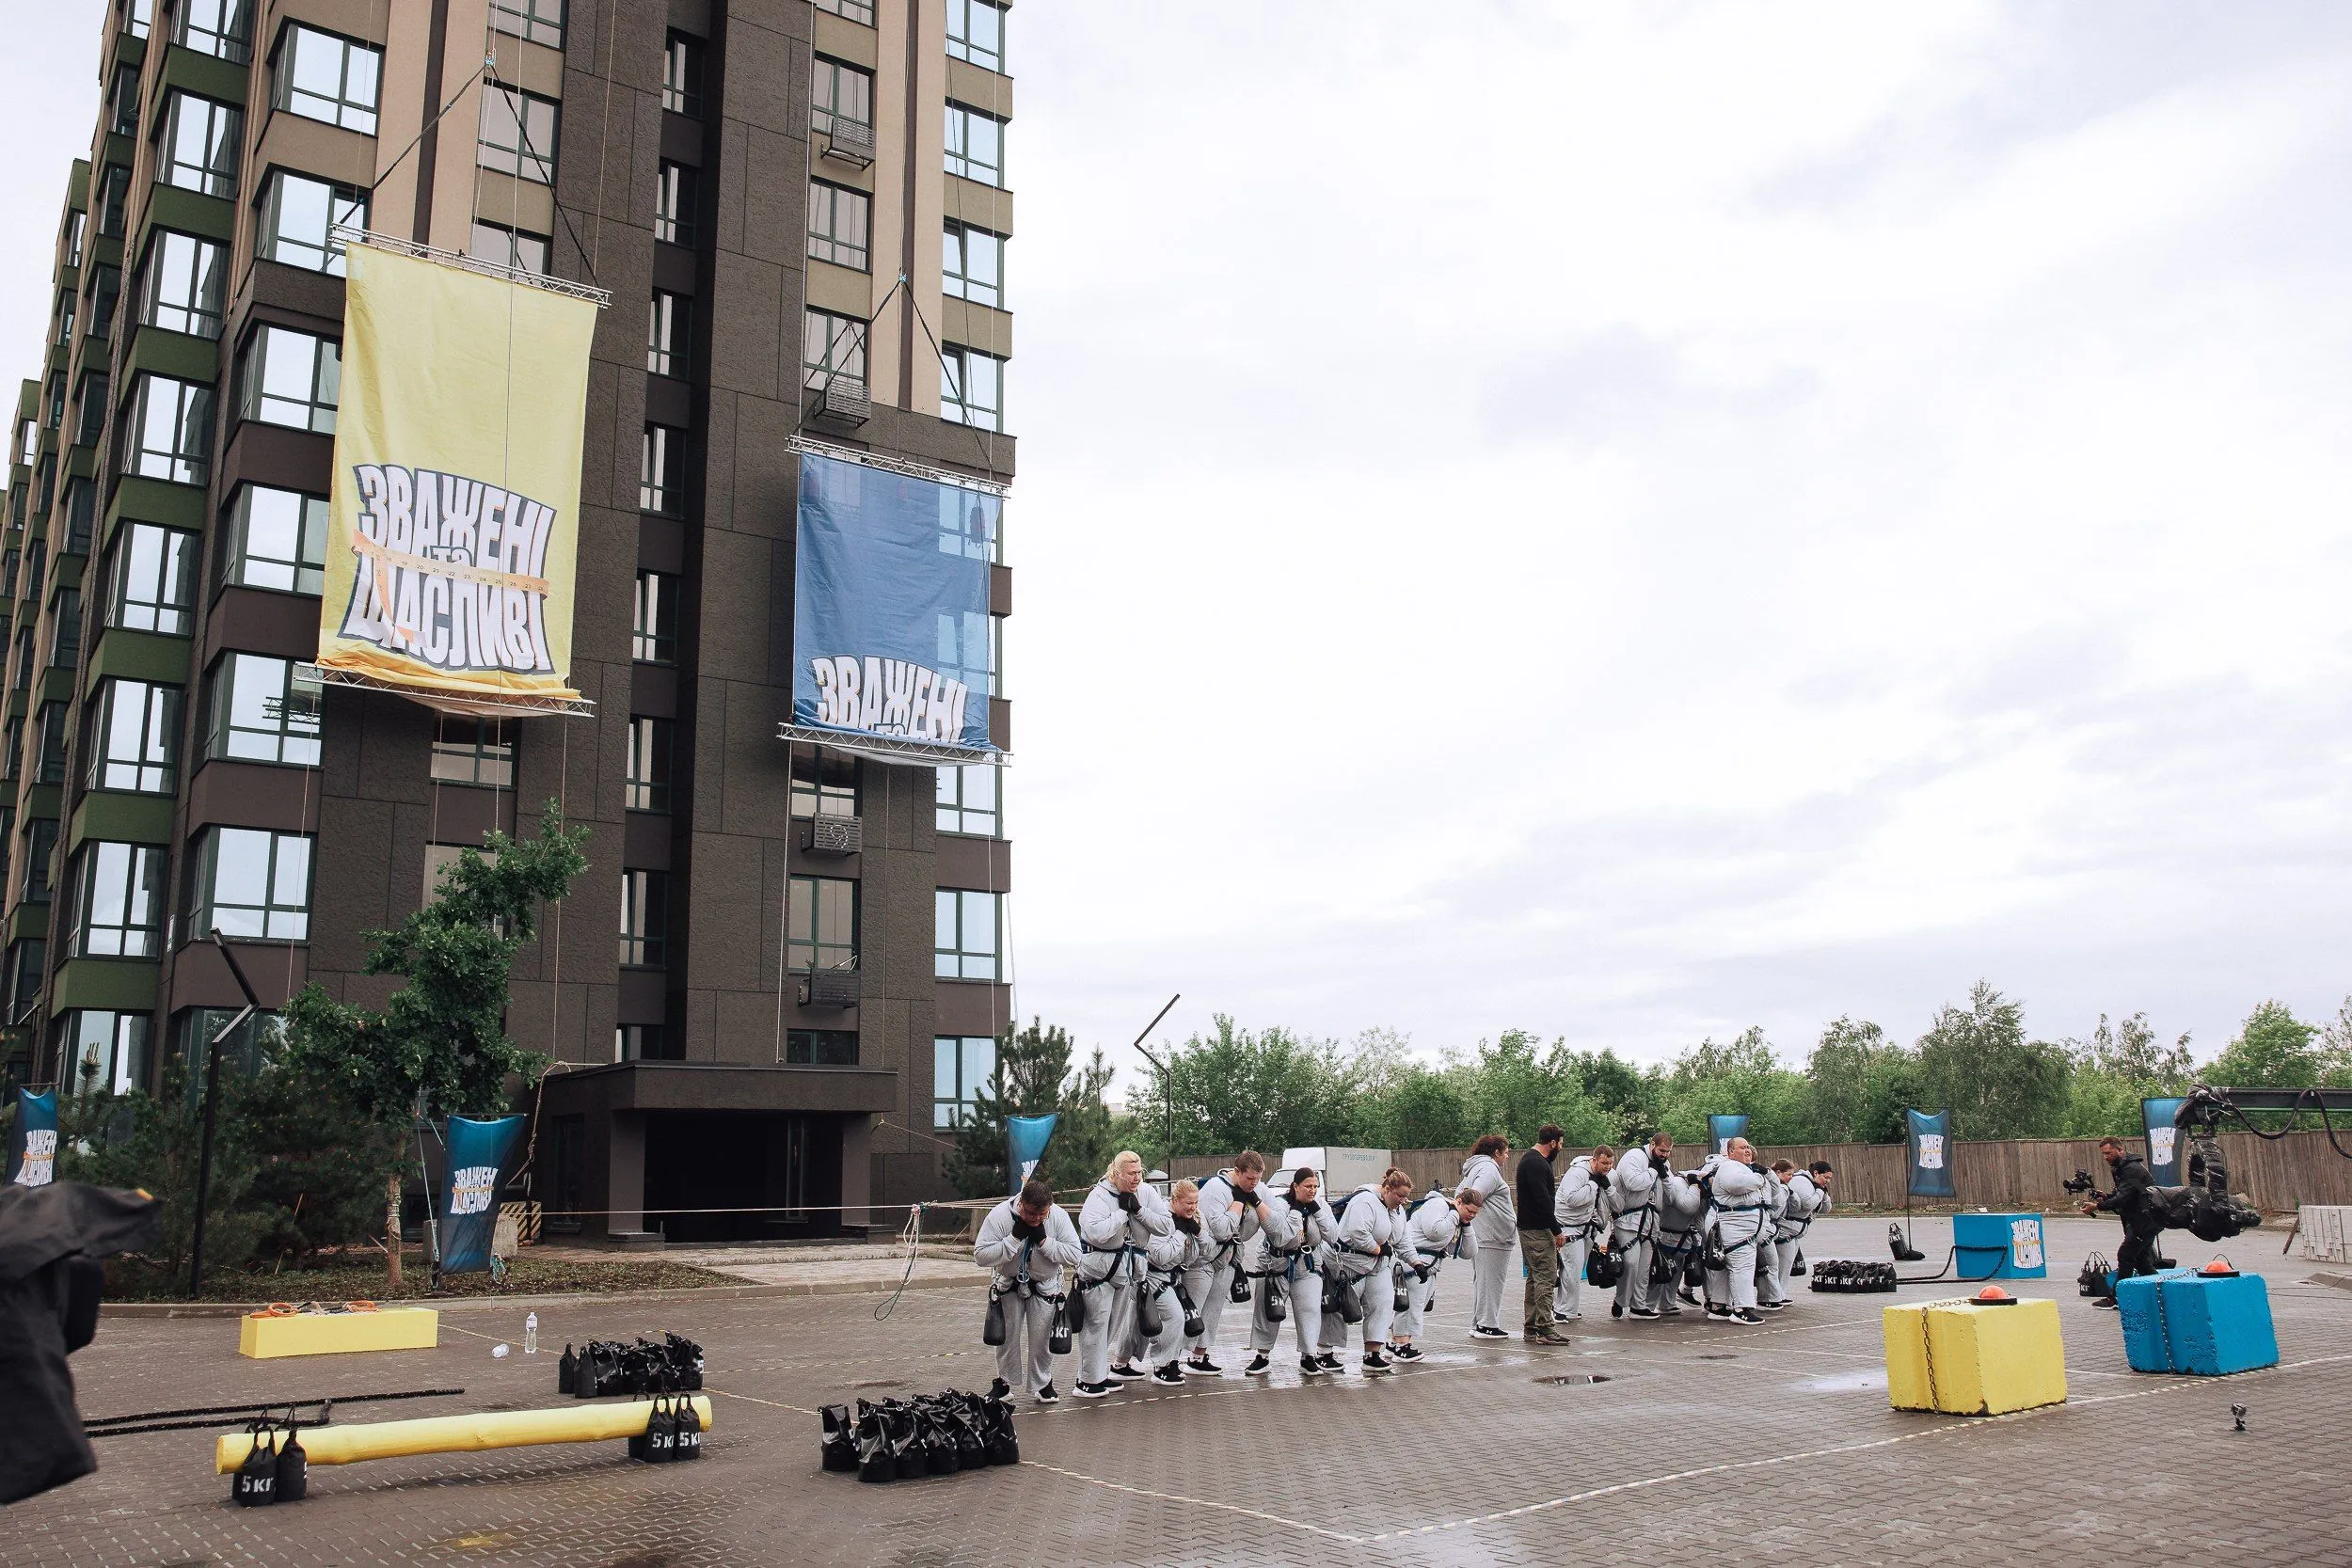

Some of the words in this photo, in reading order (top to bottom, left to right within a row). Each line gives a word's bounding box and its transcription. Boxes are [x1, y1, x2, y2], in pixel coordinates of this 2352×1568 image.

[352, 464, 557, 578] ЗВАЖЕНІ
[810, 655, 968, 740] ЗВАЖЕНІ
[652, 1432, 662, 1448] 5
[679, 1432, 690, 1447] 5
[242, 1475, 252, 1493] 5
